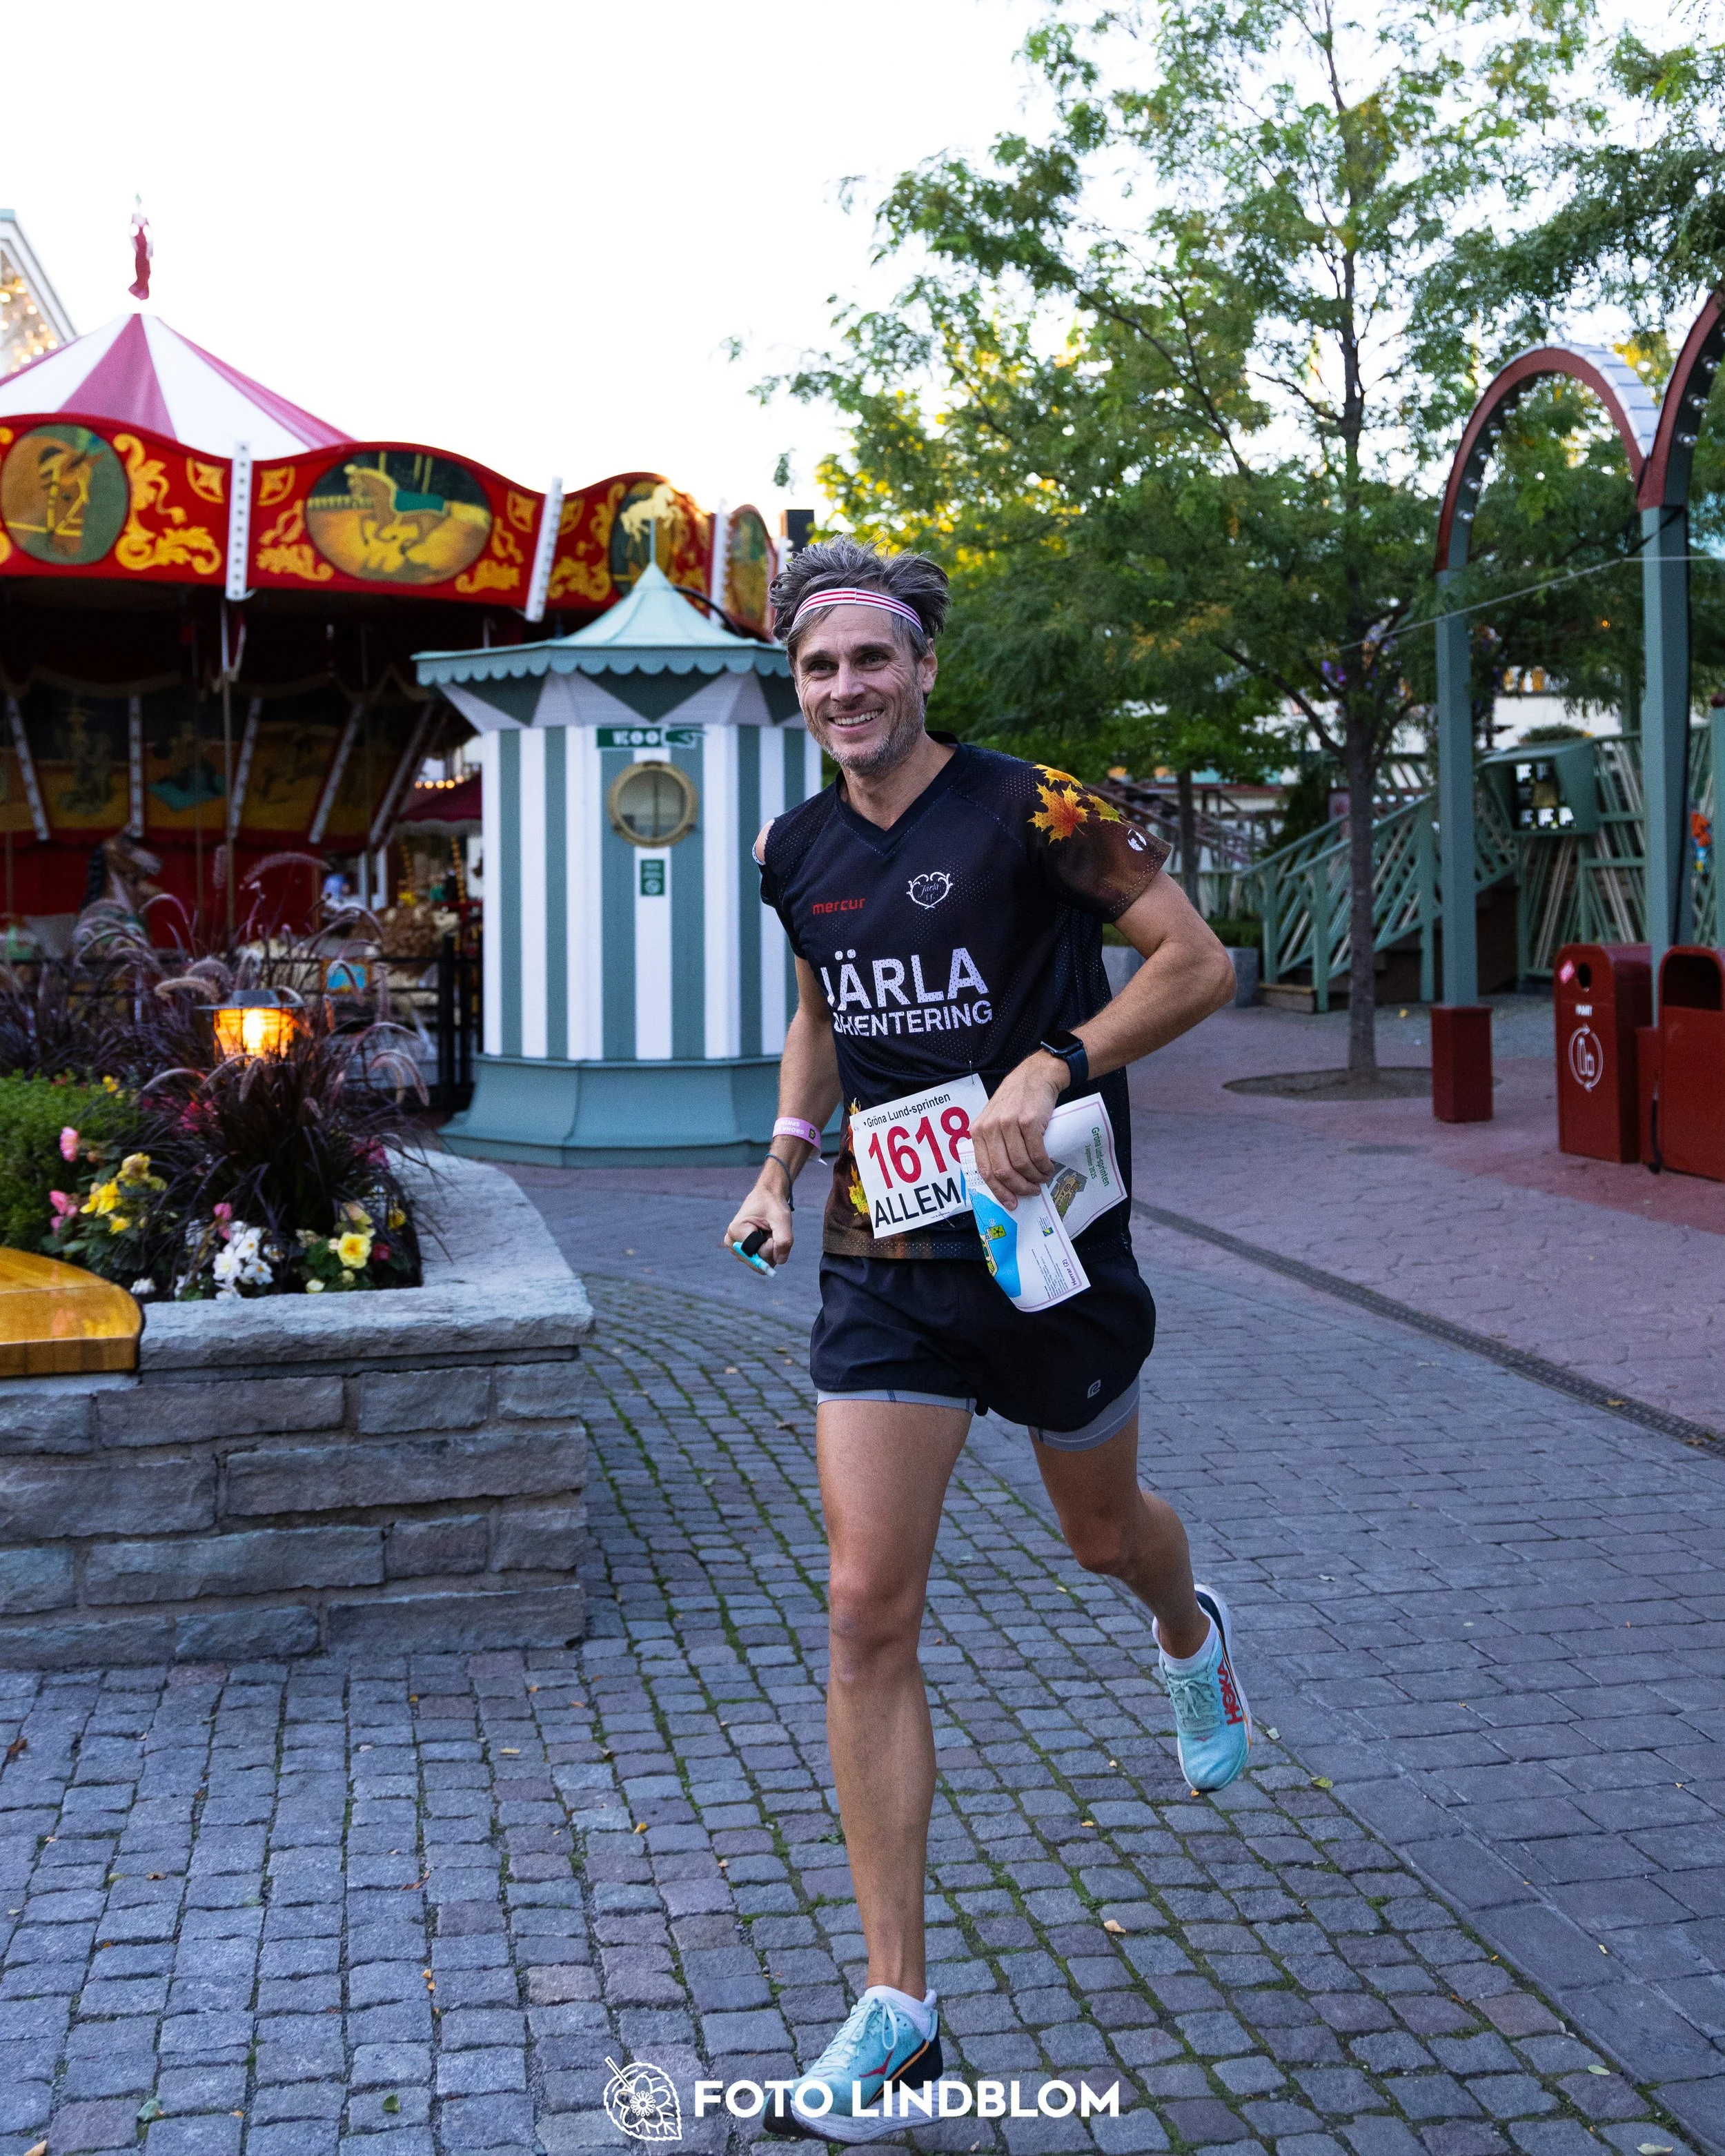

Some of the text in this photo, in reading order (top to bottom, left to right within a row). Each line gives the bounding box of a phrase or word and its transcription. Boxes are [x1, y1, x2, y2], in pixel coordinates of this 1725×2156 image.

[812, 898, 866, 916] mercur
[867, 1092, 951, 1128] Gröna Lund-sprinten
[1092, 1127, 1102, 1147] Gröna
[868, 1106, 972, 1190] 1618
[1089, 1166, 1097, 1180] 2025
[1067, 1268, 1077, 1286] Herrar
